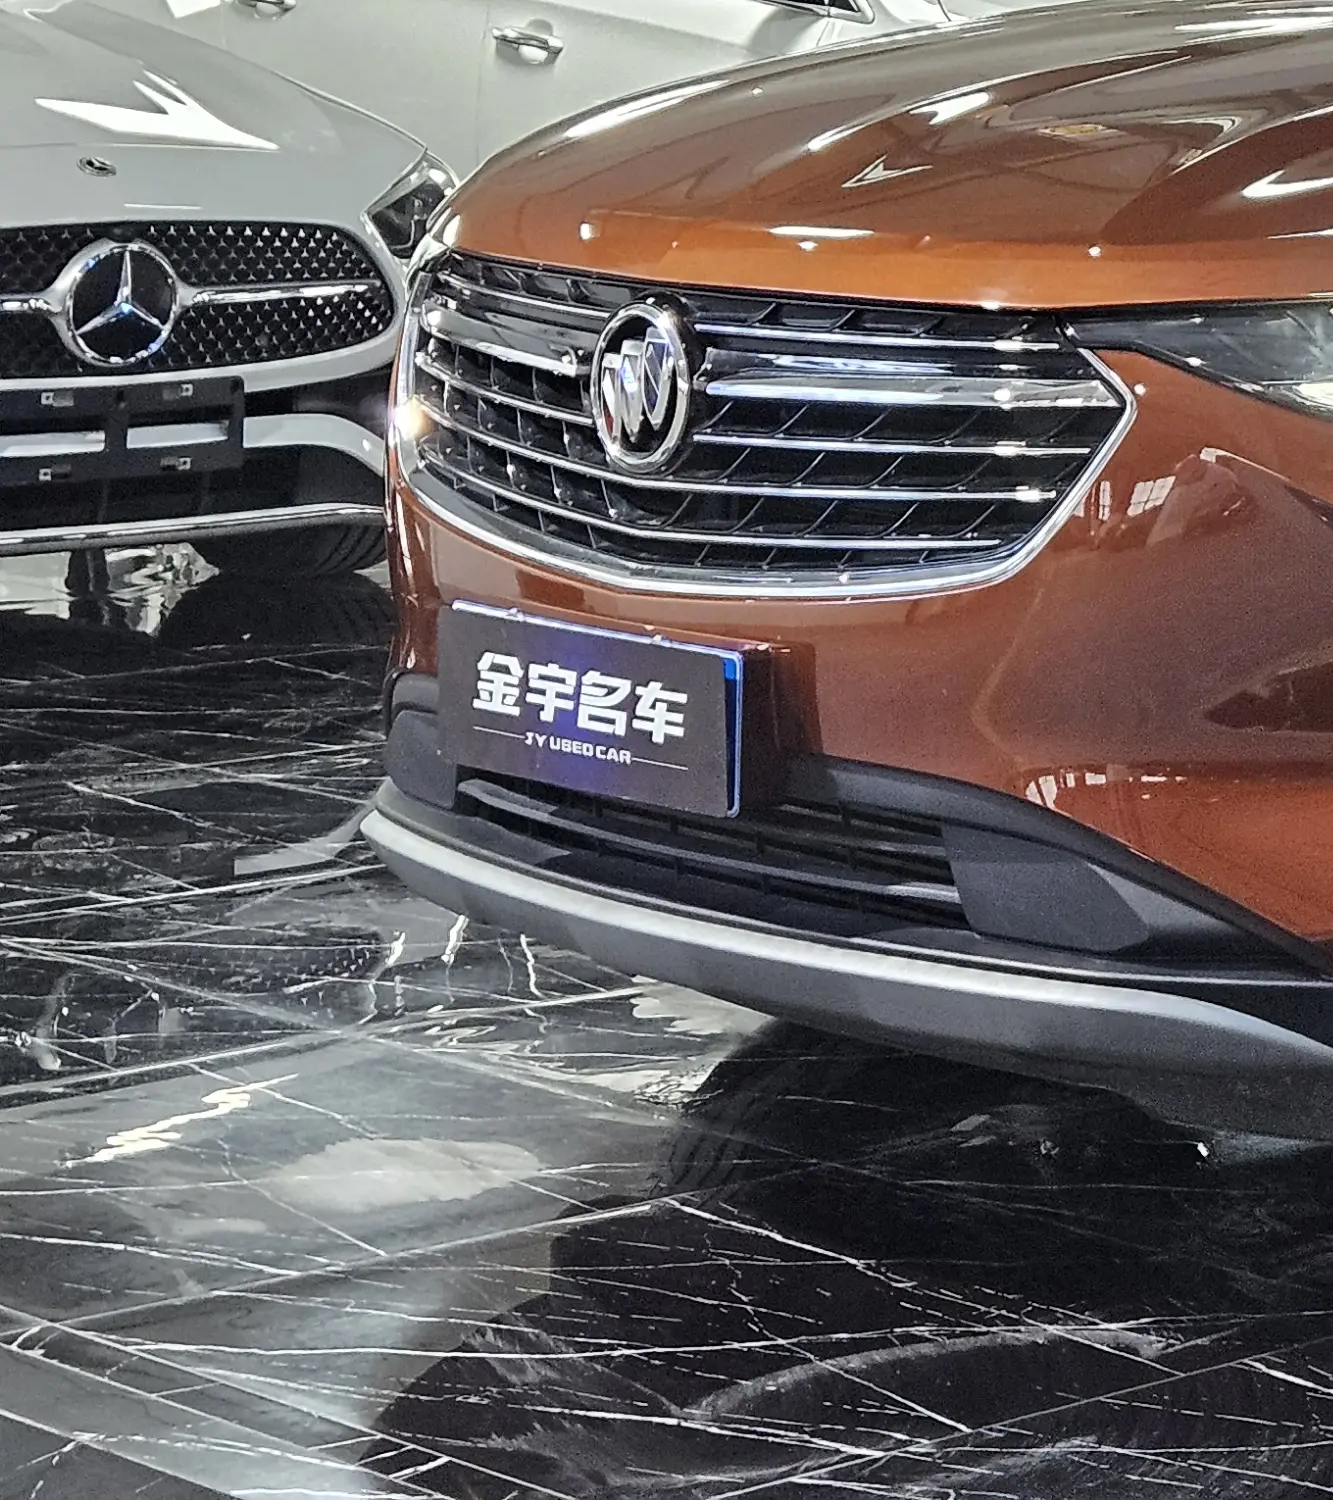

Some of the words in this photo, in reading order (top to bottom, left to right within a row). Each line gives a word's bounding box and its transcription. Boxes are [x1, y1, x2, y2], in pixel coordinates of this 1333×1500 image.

[471, 650, 688, 746] 金宇名车
[524, 732, 547, 748] JY
[596, 745, 632, 765] CAR
